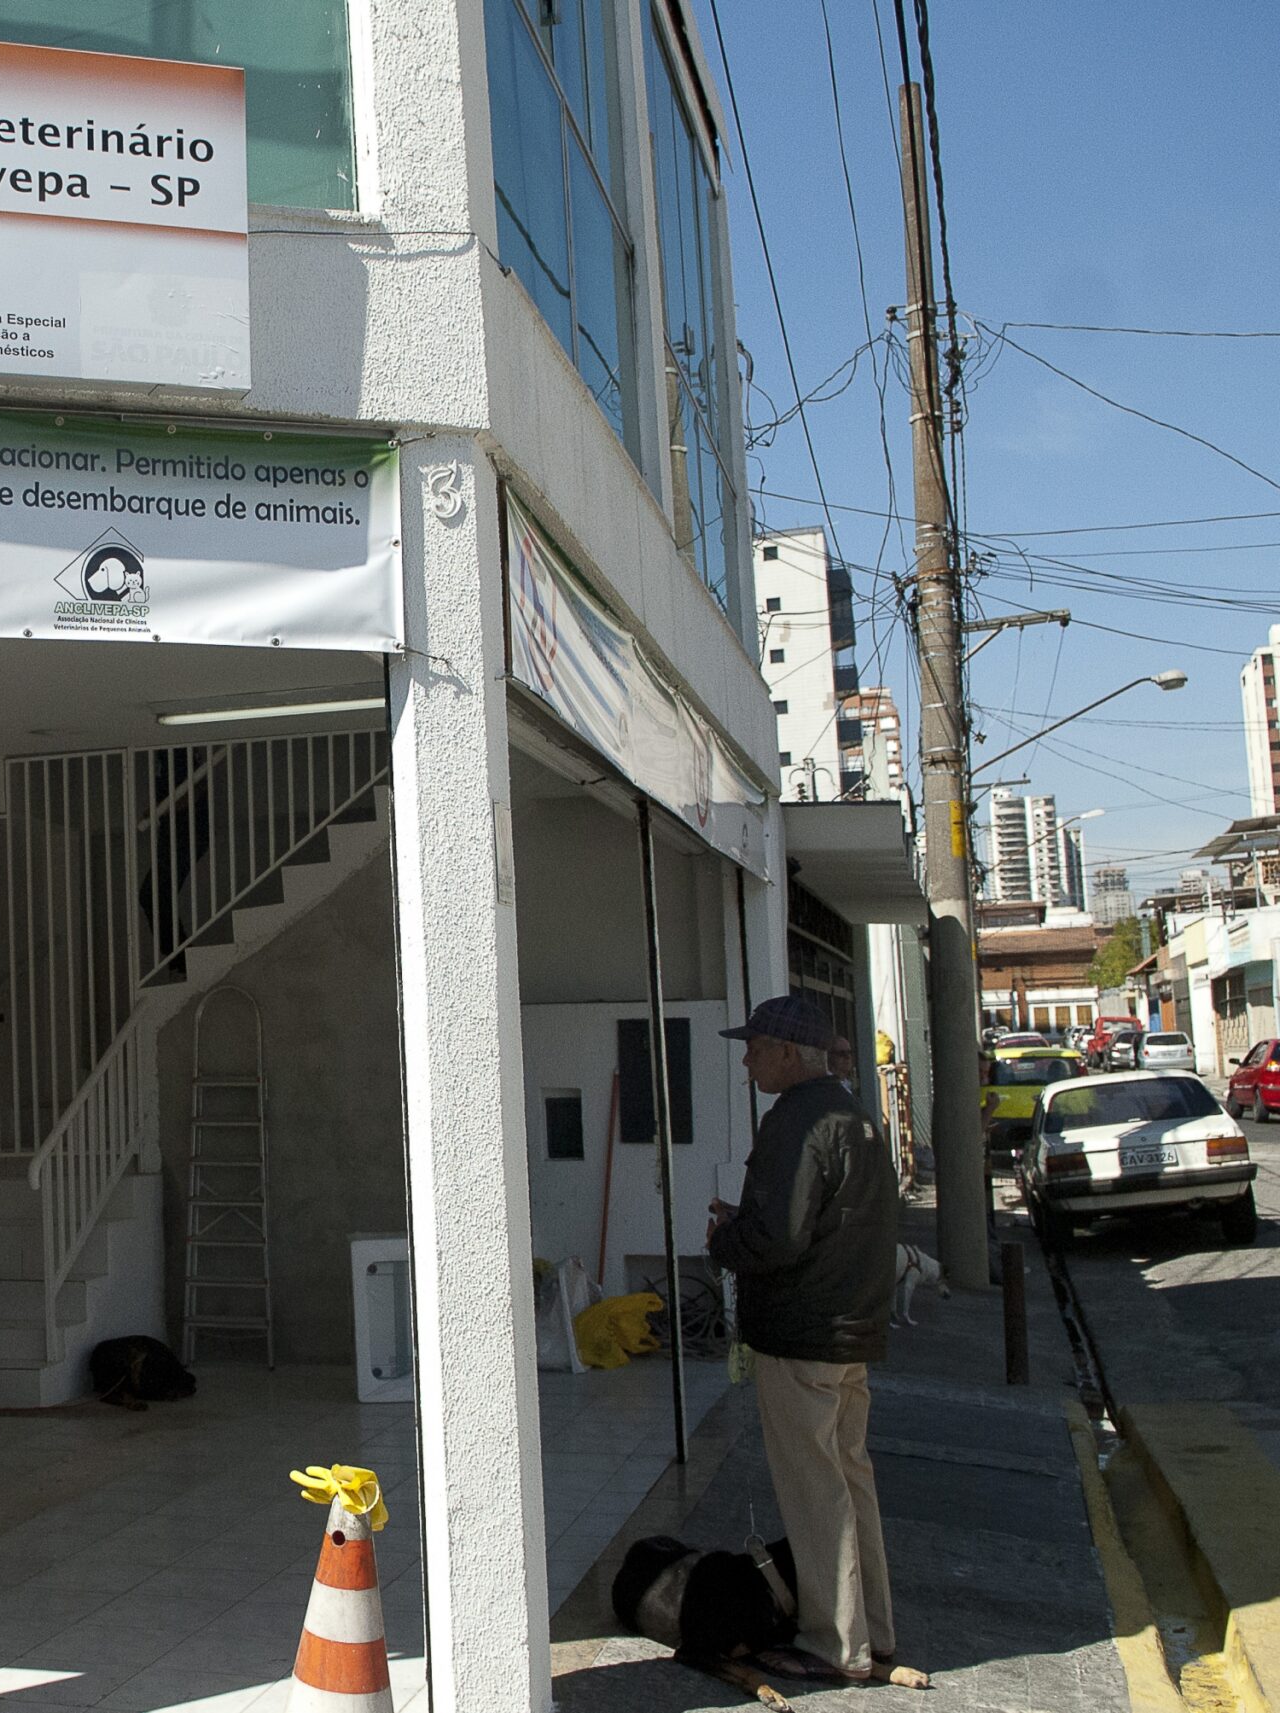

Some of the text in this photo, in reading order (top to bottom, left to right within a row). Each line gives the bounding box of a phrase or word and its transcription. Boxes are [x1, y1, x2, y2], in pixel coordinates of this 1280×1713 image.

[151, 174, 200, 207] SP
[7, 313, 66, 328] Especial
[23, 332, 31, 341] a
[116, 449, 246, 481] Permitido
[255, 463, 347, 488] apenas
[354, 470, 369, 488] o
[22, 482, 206, 520] desembarque
[214, 493, 247, 519] de
[255, 499, 360, 525] animais.
[54, 601, 150, 618] ANCLIVEPA-SP
